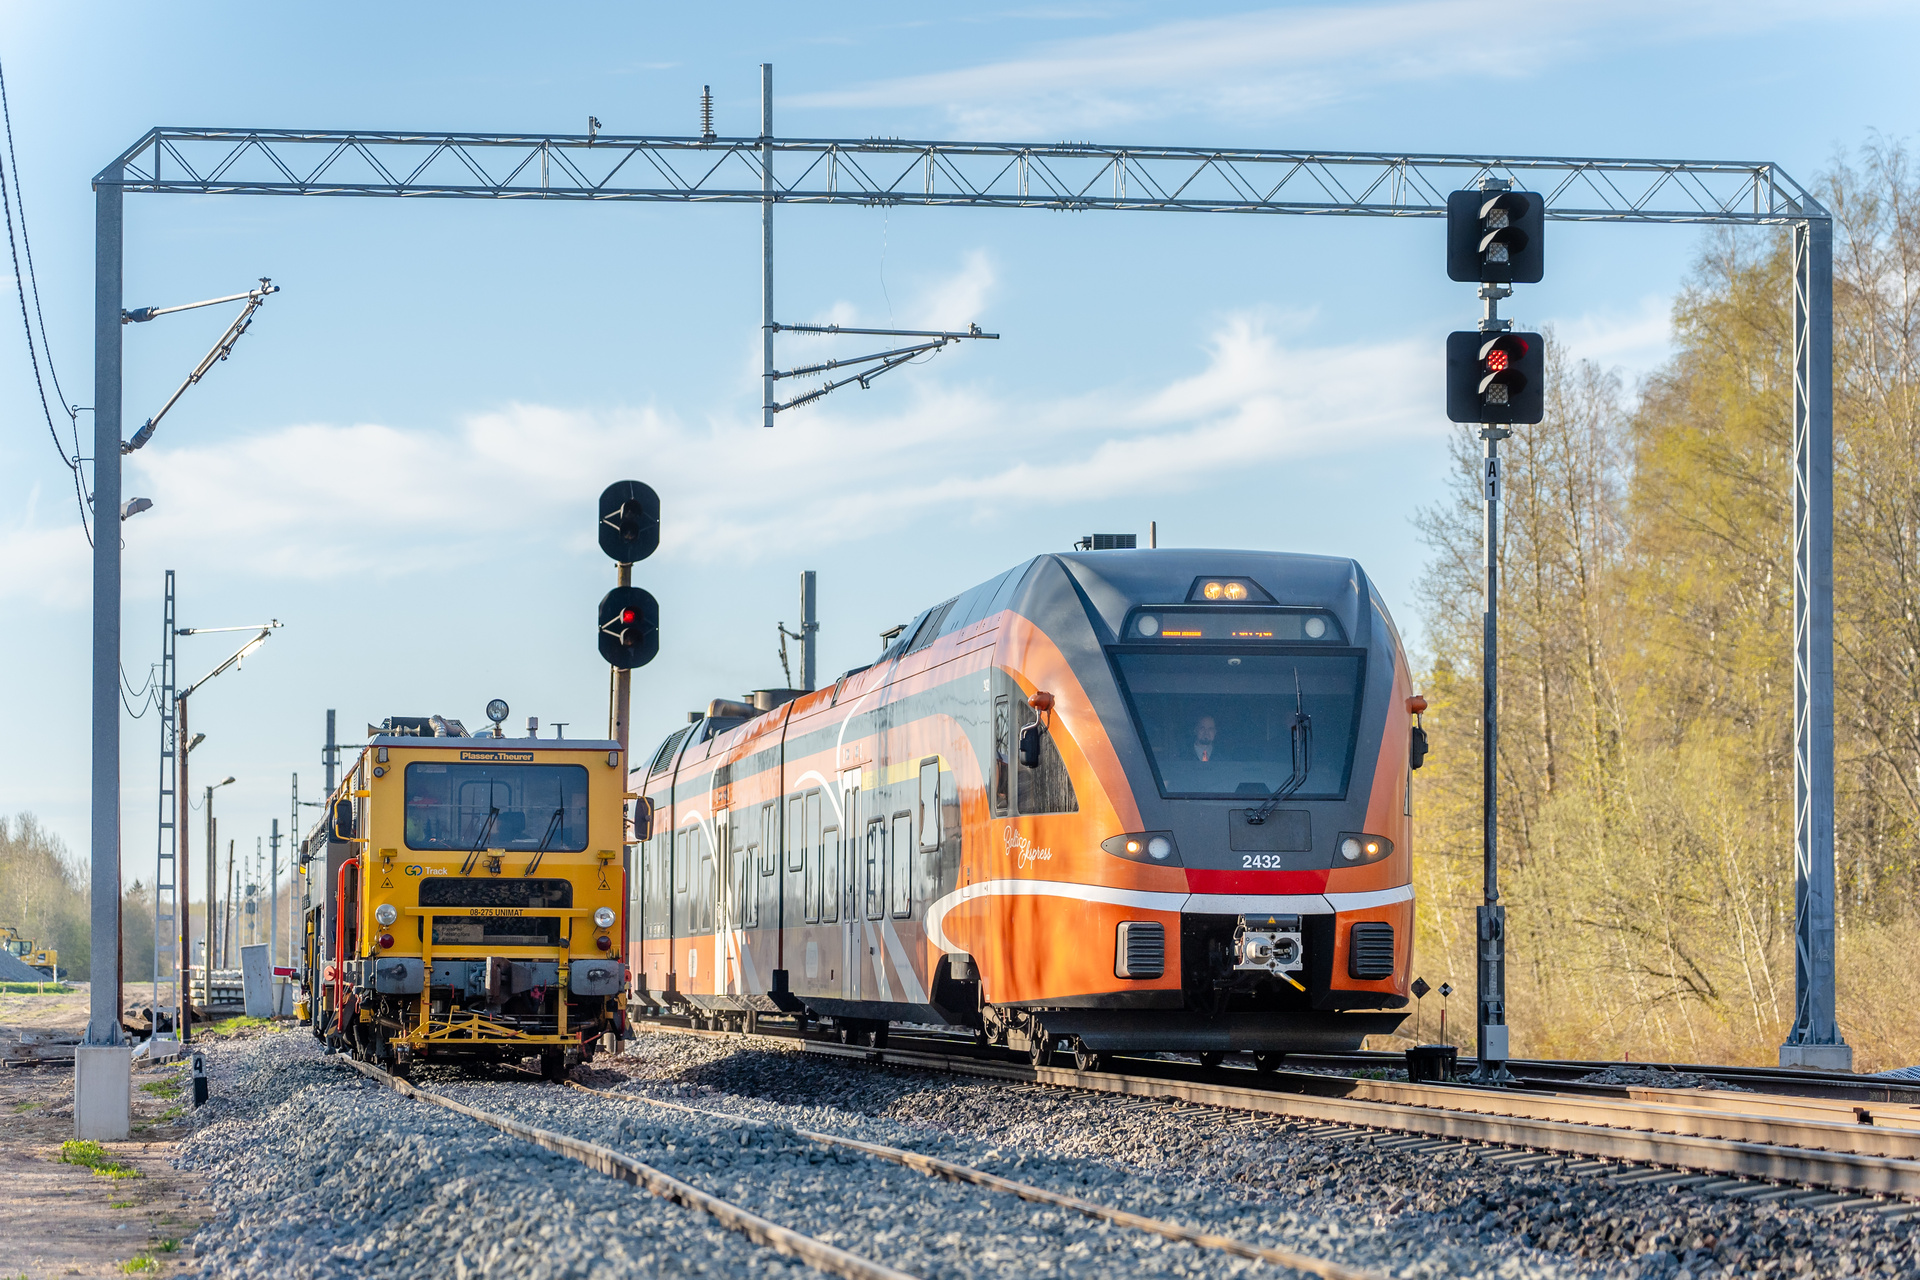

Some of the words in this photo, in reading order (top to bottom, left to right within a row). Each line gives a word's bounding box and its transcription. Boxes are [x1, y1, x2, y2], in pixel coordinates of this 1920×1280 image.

[462, 752, 494, 760] Plasser
[498, 753, 532, 761] Theurer
[1242, 854, 1281, 869] 2432
[425, 866, 448, 876] Track
[470, 908, 494, 916] 08-275
[495, 909, 524, 917] UNIMAT
[194, 1058, 203, 1073] 4
